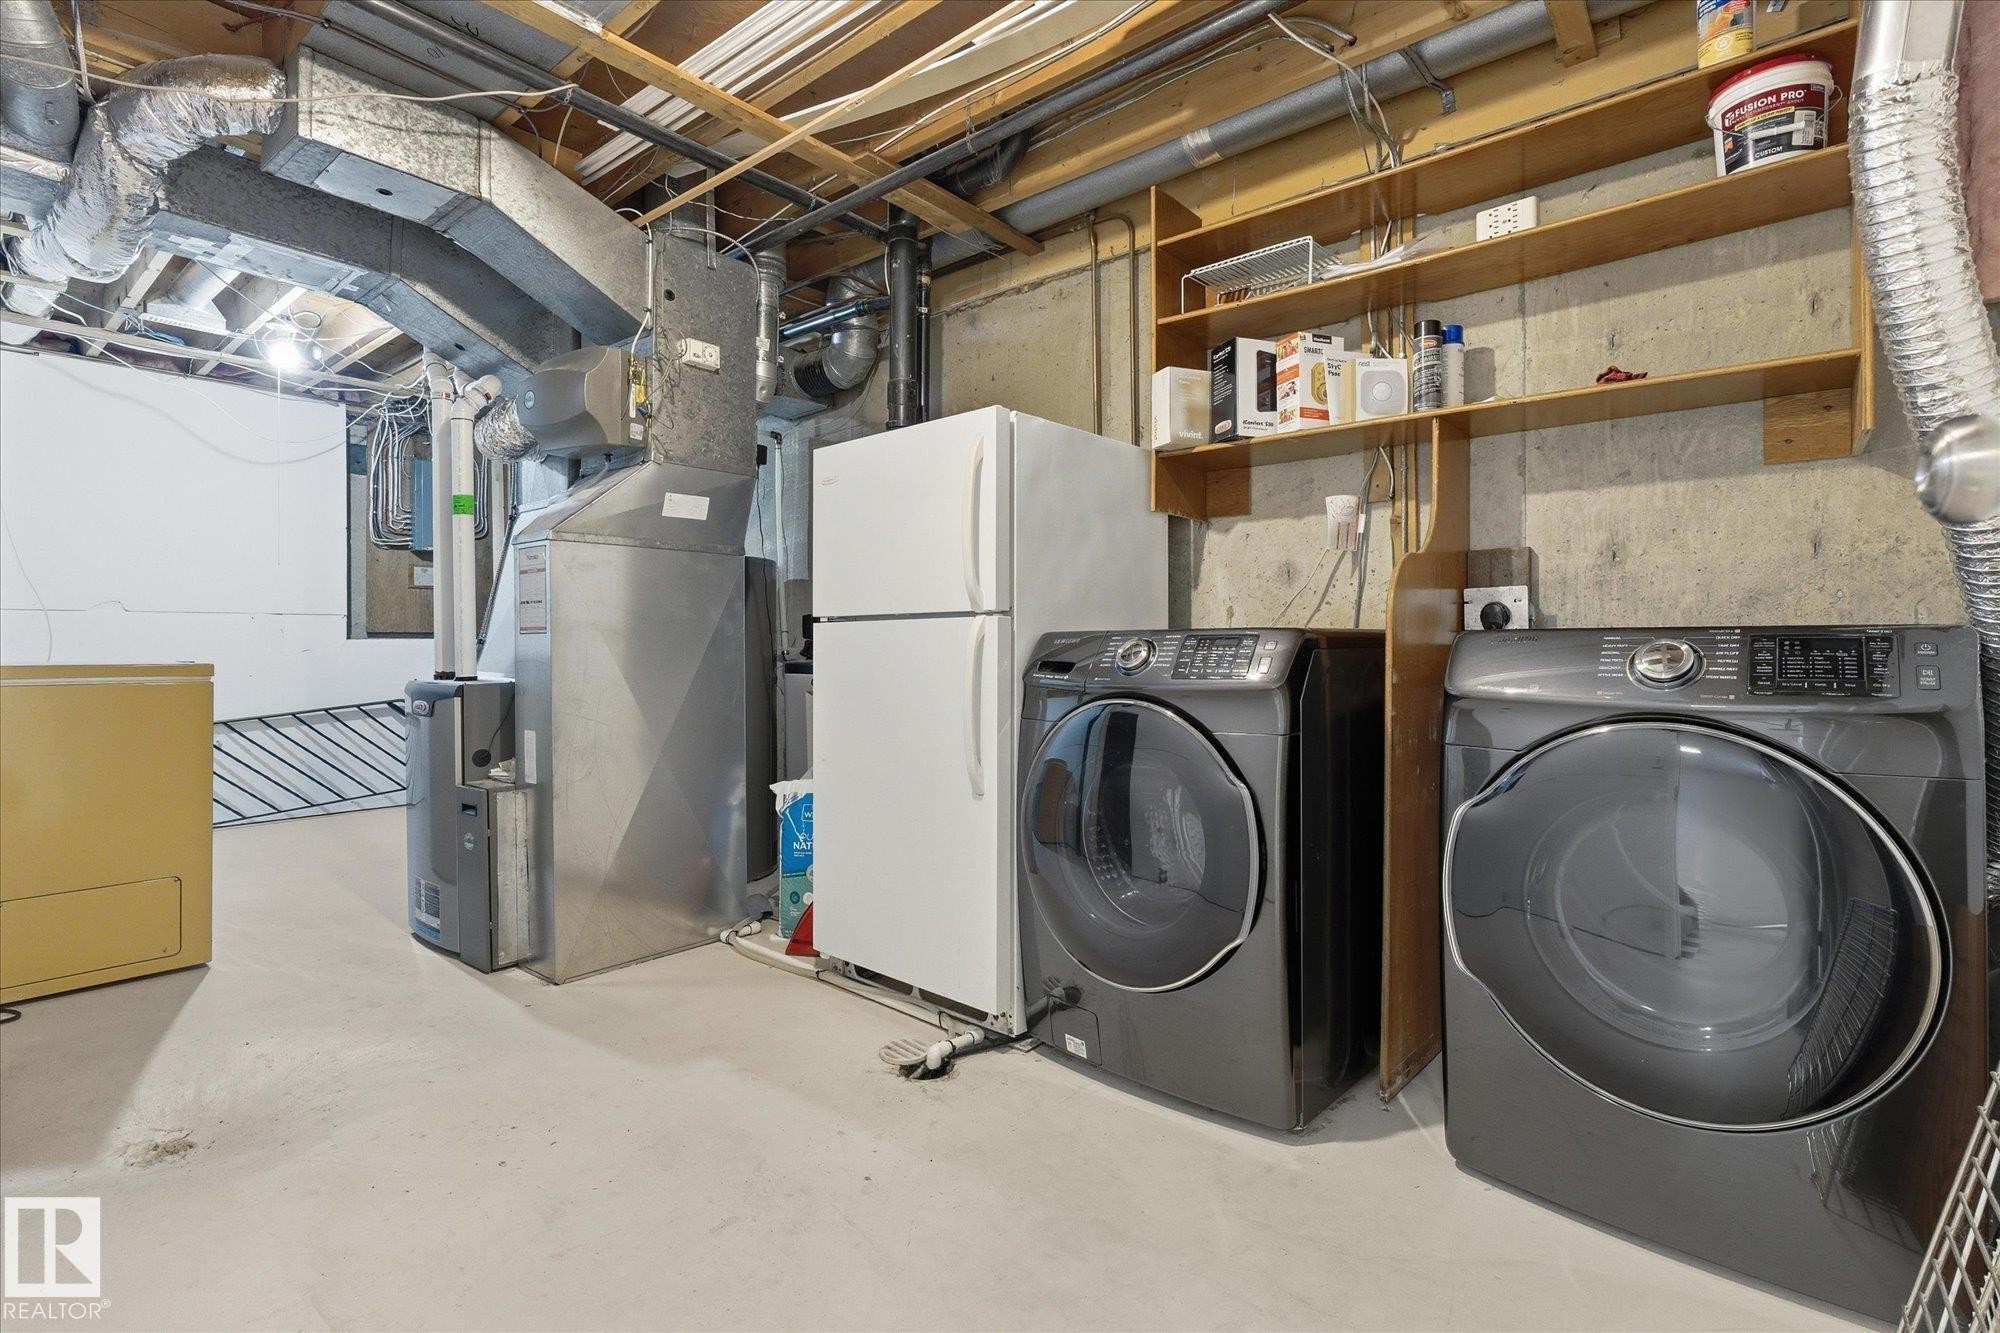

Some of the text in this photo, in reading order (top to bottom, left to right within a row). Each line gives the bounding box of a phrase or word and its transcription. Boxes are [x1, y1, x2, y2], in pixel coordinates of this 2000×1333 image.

[1735, 89, 1804, 117] FUSION PRO
[1754, 146, 1783, 158] CUSTOM
